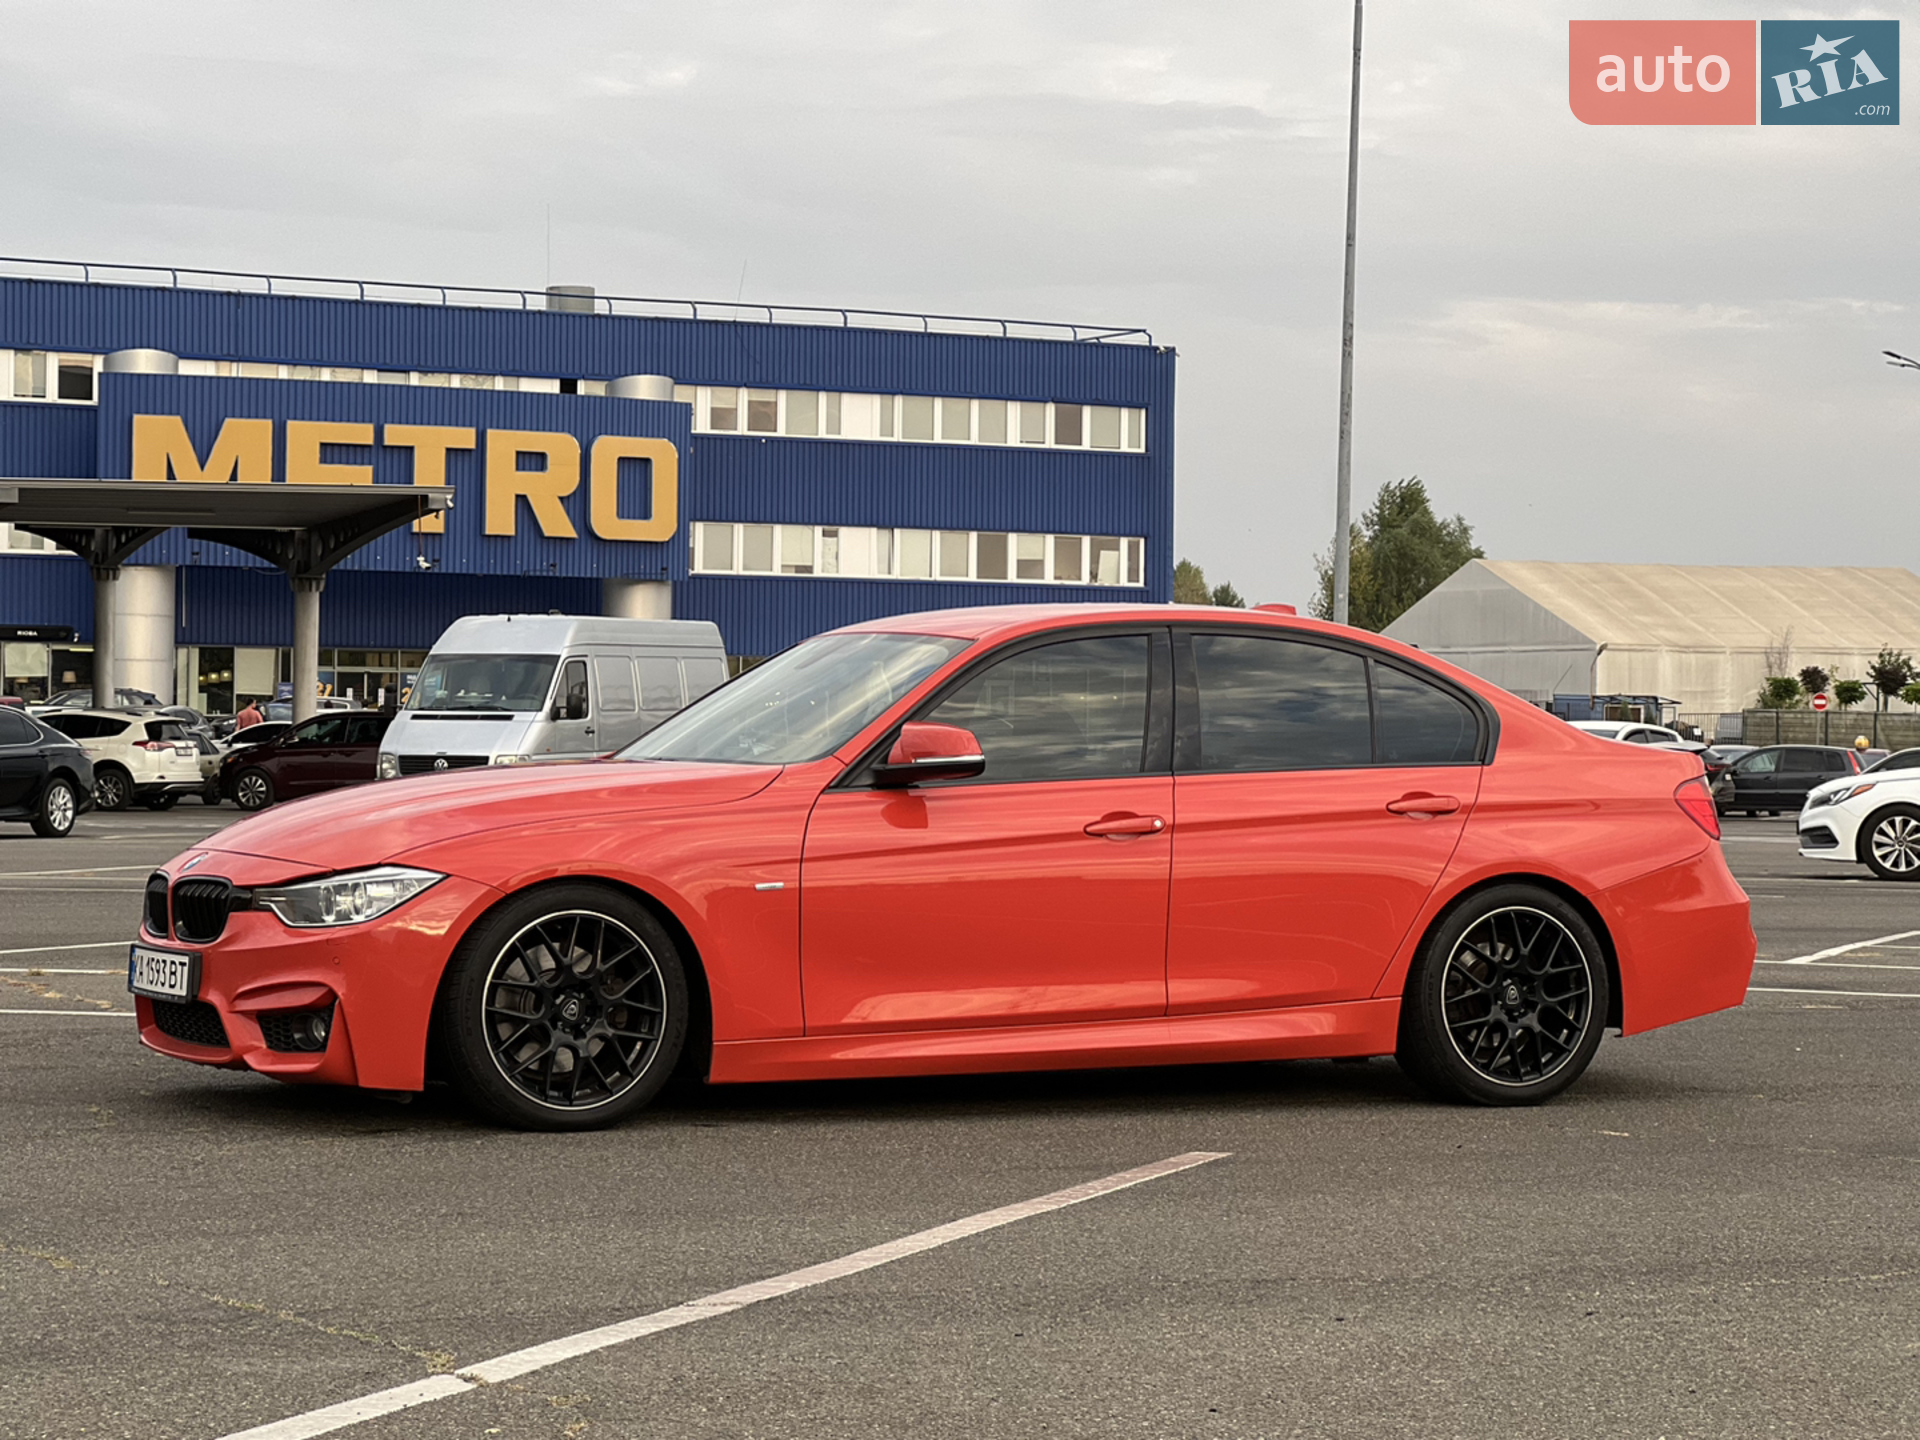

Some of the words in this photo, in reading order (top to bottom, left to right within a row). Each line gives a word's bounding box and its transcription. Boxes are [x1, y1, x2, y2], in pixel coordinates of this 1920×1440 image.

[132, 413, 678, 543] METRO
[146, 956, 167, 987] 1593
[169, 959, 187, 990] BT
